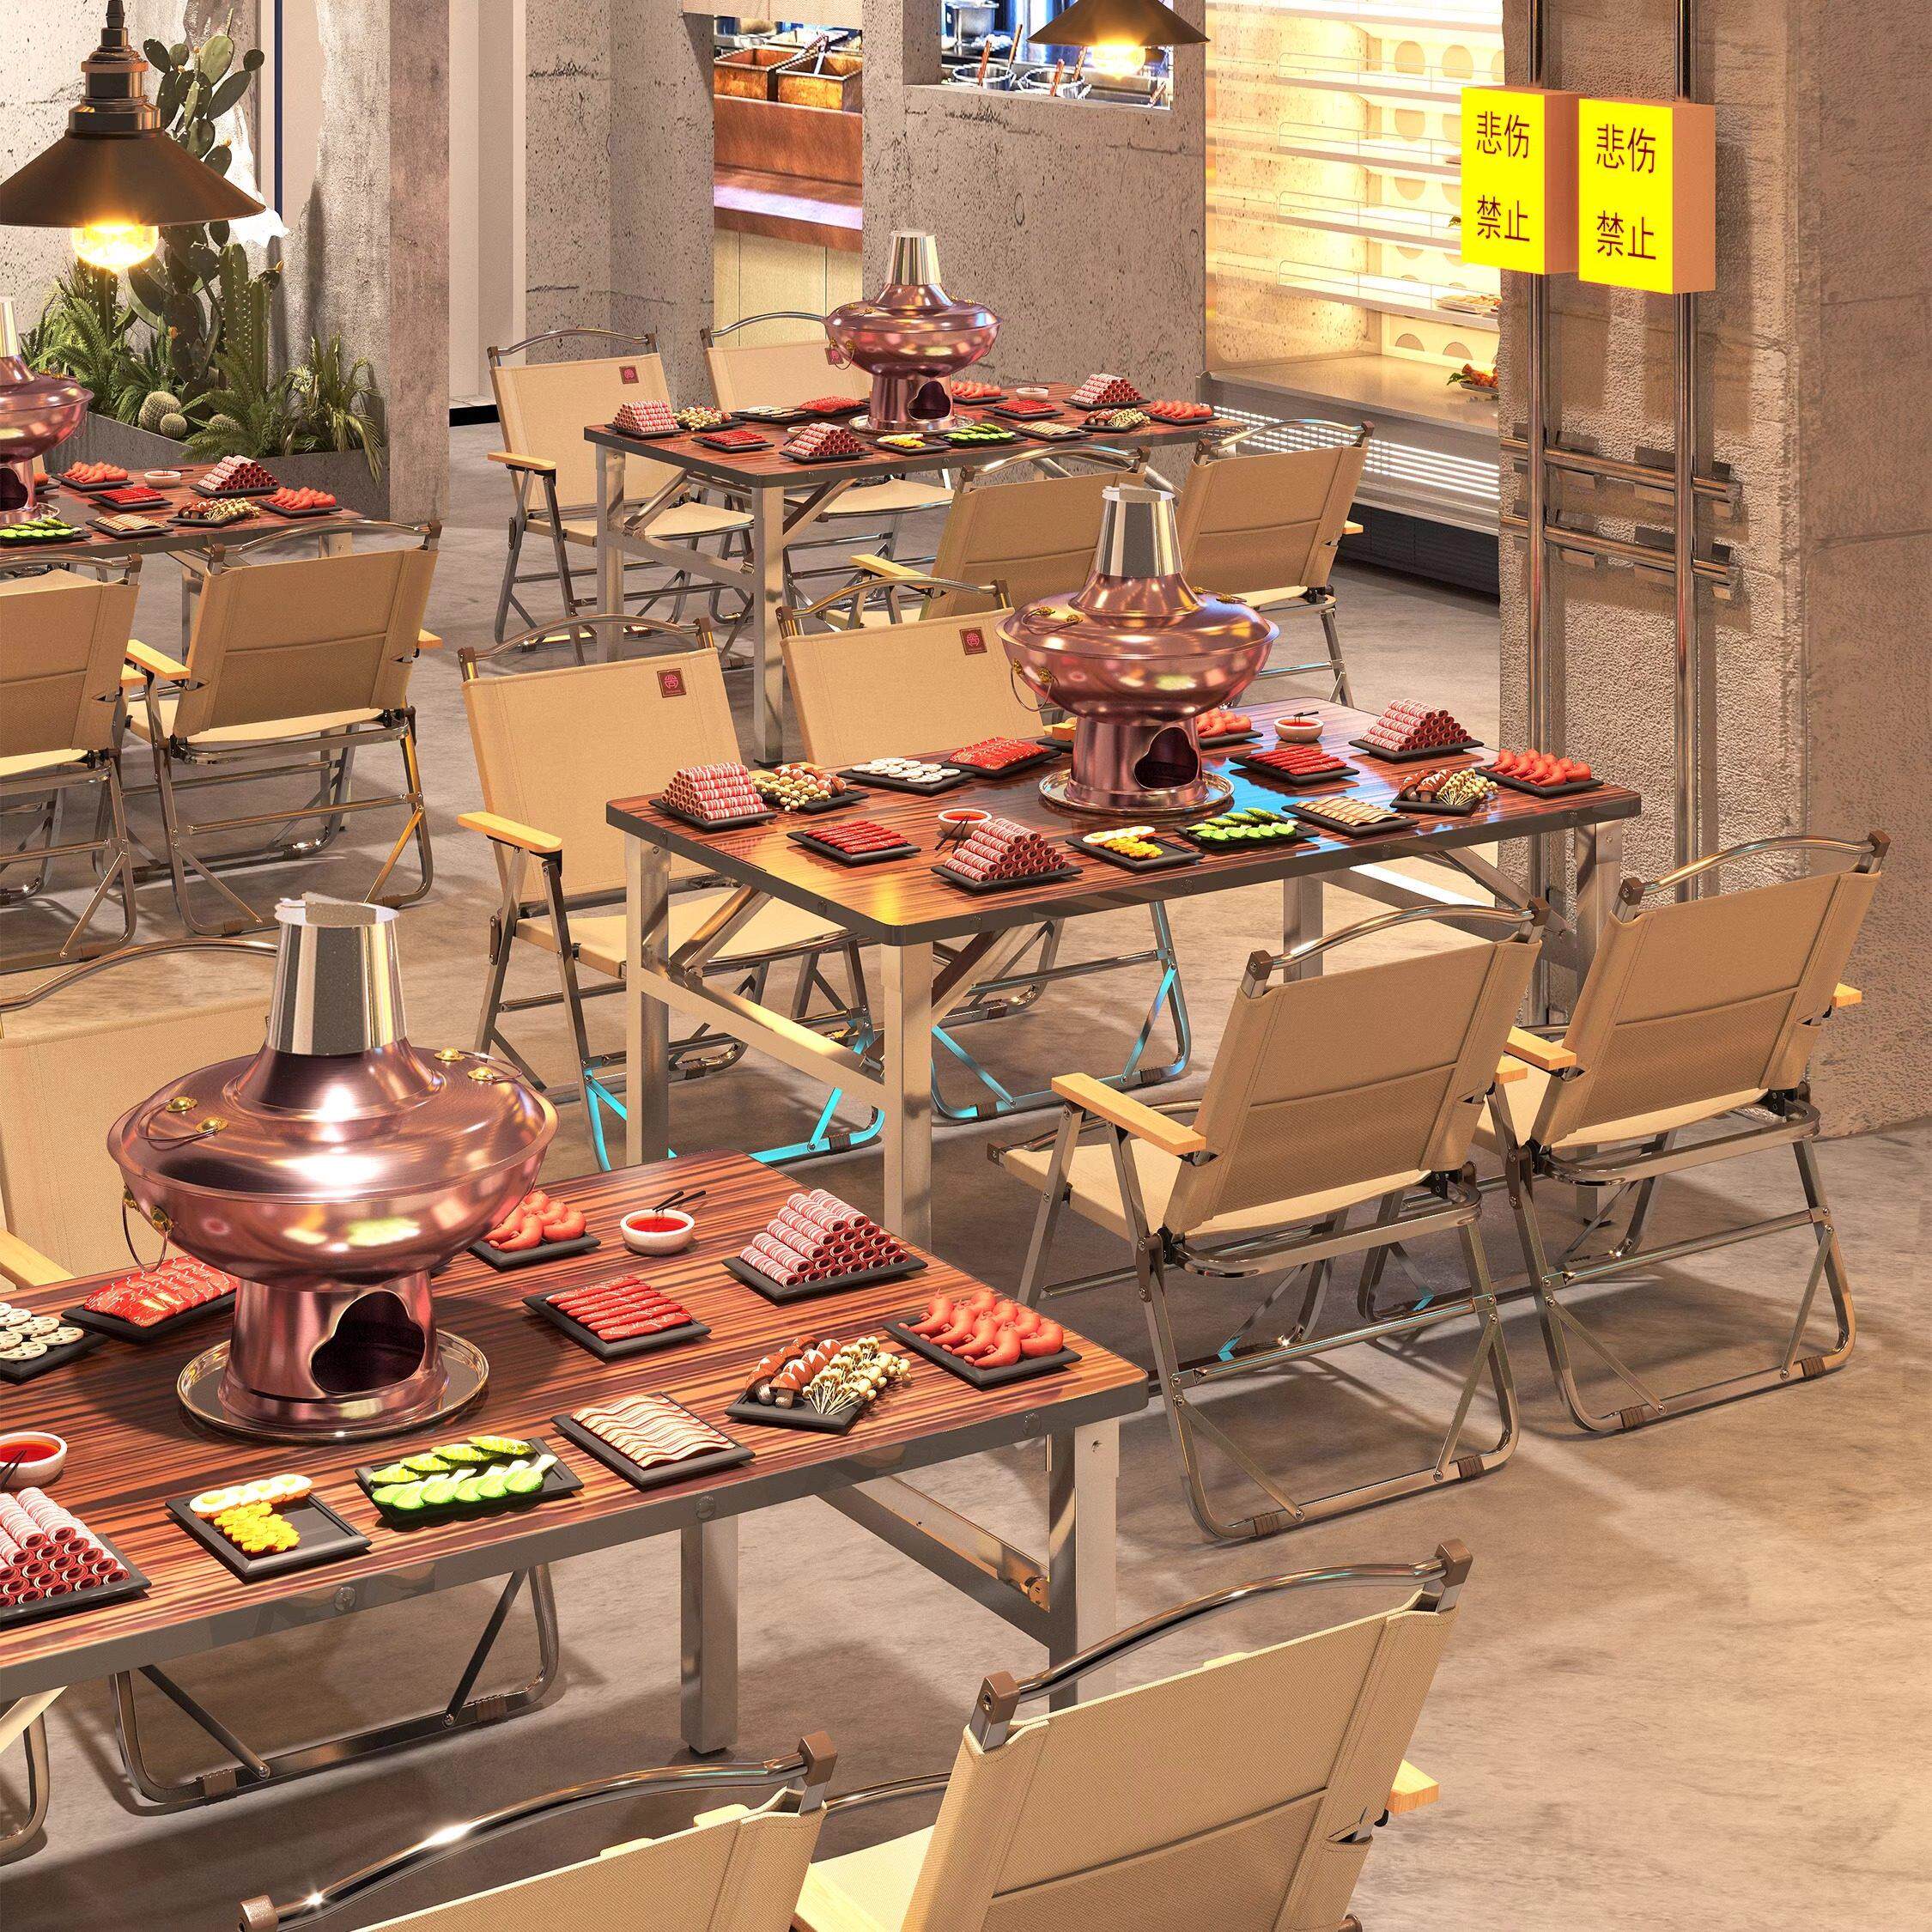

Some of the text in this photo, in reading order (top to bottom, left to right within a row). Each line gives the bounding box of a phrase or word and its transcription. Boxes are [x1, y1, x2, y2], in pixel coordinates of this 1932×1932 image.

[1476, 111, 1530, 159] 悲伤
[1596, 124, 1656, 174] 悲伤
[1476, 194, 1530, 242] 禁止
[1596, 210, 1656, 260] 禁止
